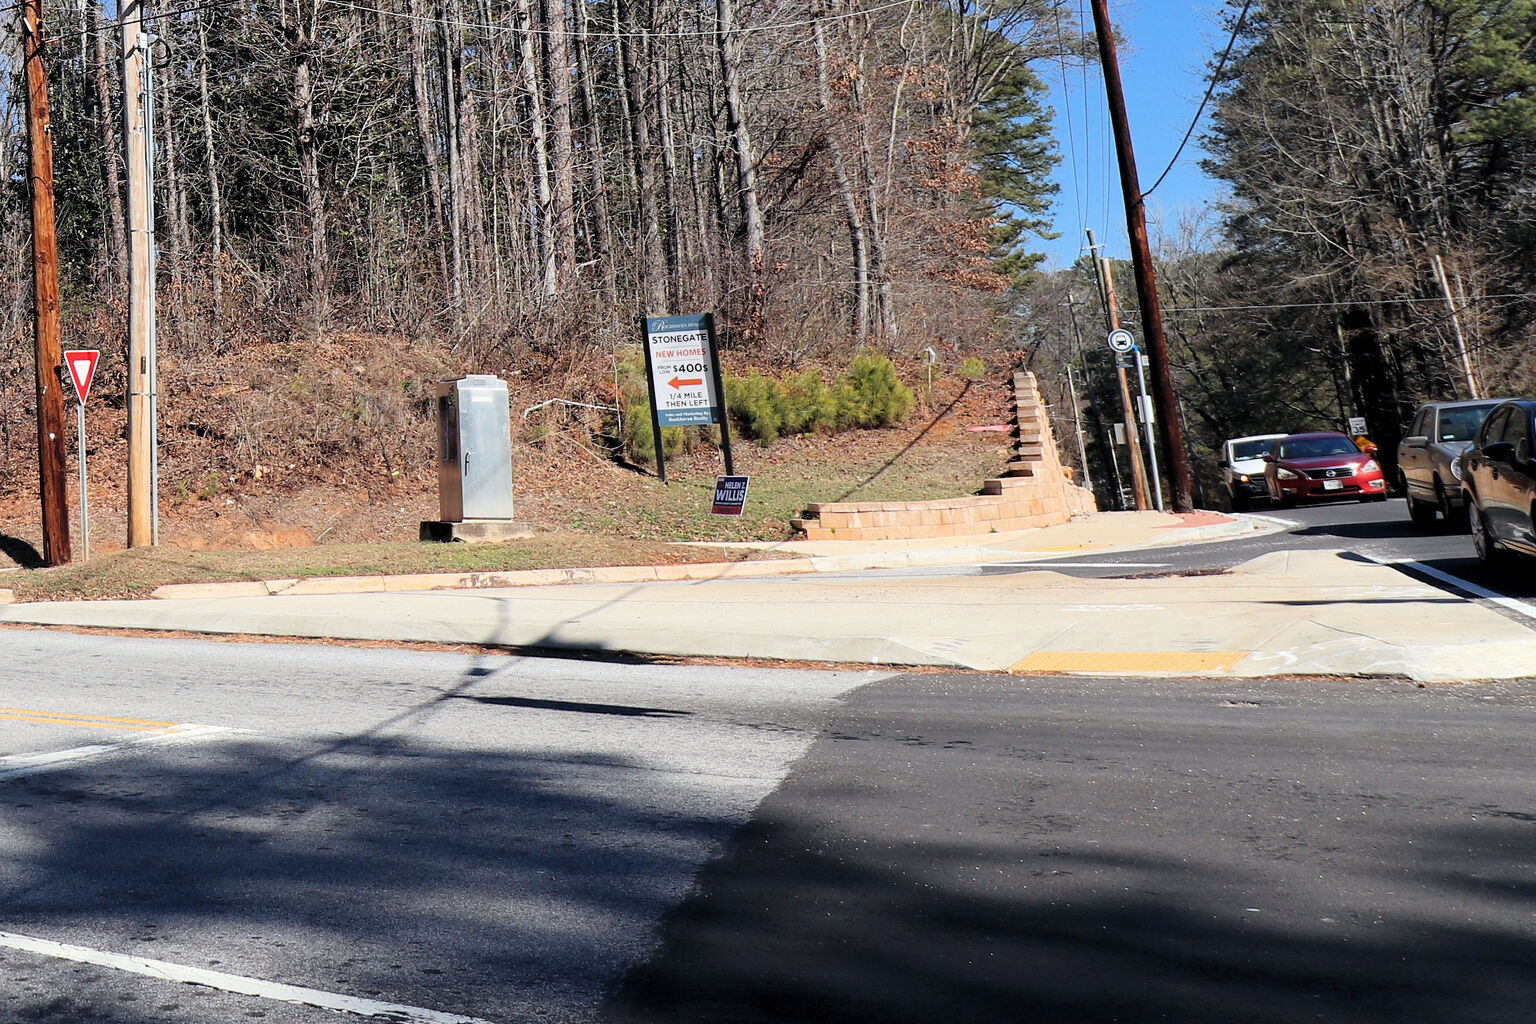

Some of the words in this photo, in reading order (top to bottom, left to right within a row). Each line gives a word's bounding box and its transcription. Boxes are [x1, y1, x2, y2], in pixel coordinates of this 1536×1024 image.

[652, 333, 707, 344] STONEGATE
[677, 348, 706, 356] HOMES
[716, 489, 744, 501] WILLIS
